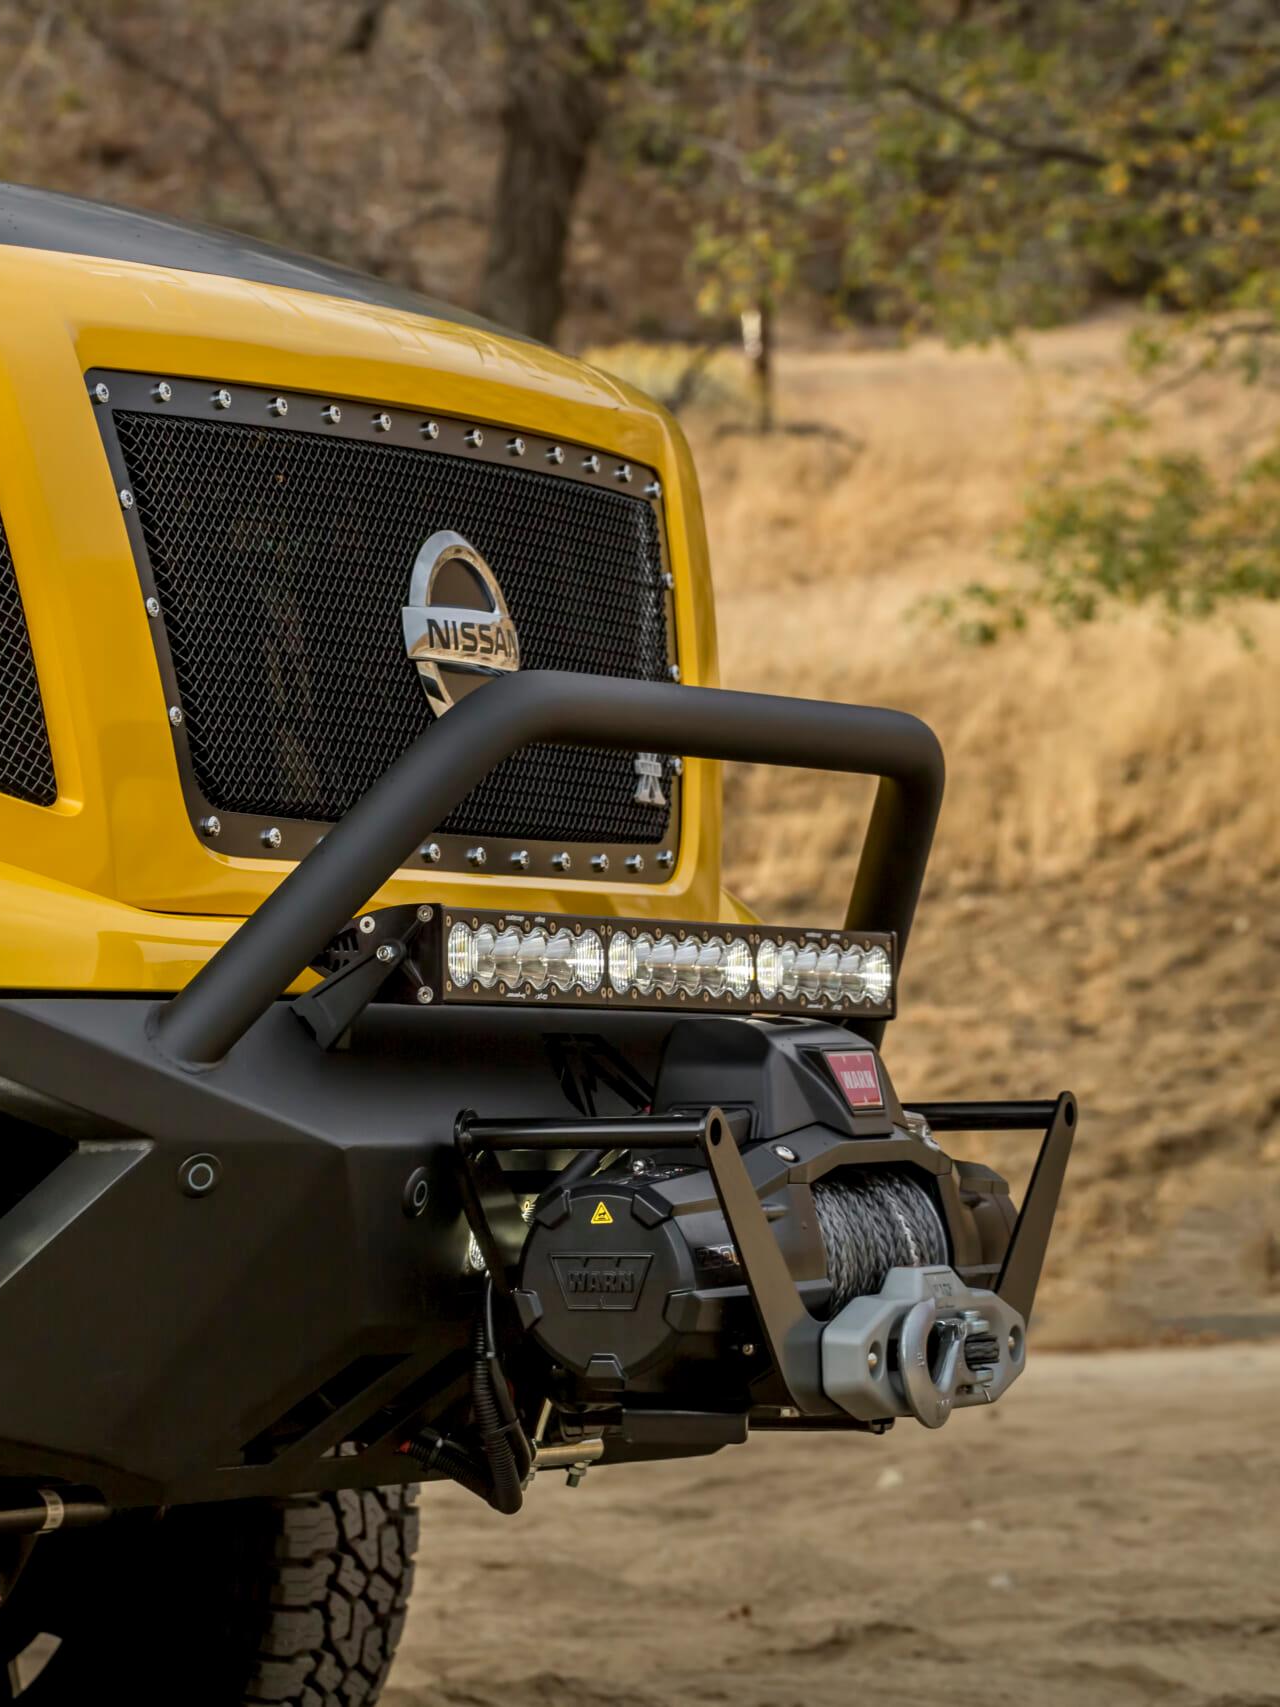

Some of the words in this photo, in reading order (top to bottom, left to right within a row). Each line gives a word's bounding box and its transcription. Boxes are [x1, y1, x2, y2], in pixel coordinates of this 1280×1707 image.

[426, 618, 519, 658] NISSAN
[841, 1070, 876, 1089] WARN
[568, 1270, 635, 1293] WARN
